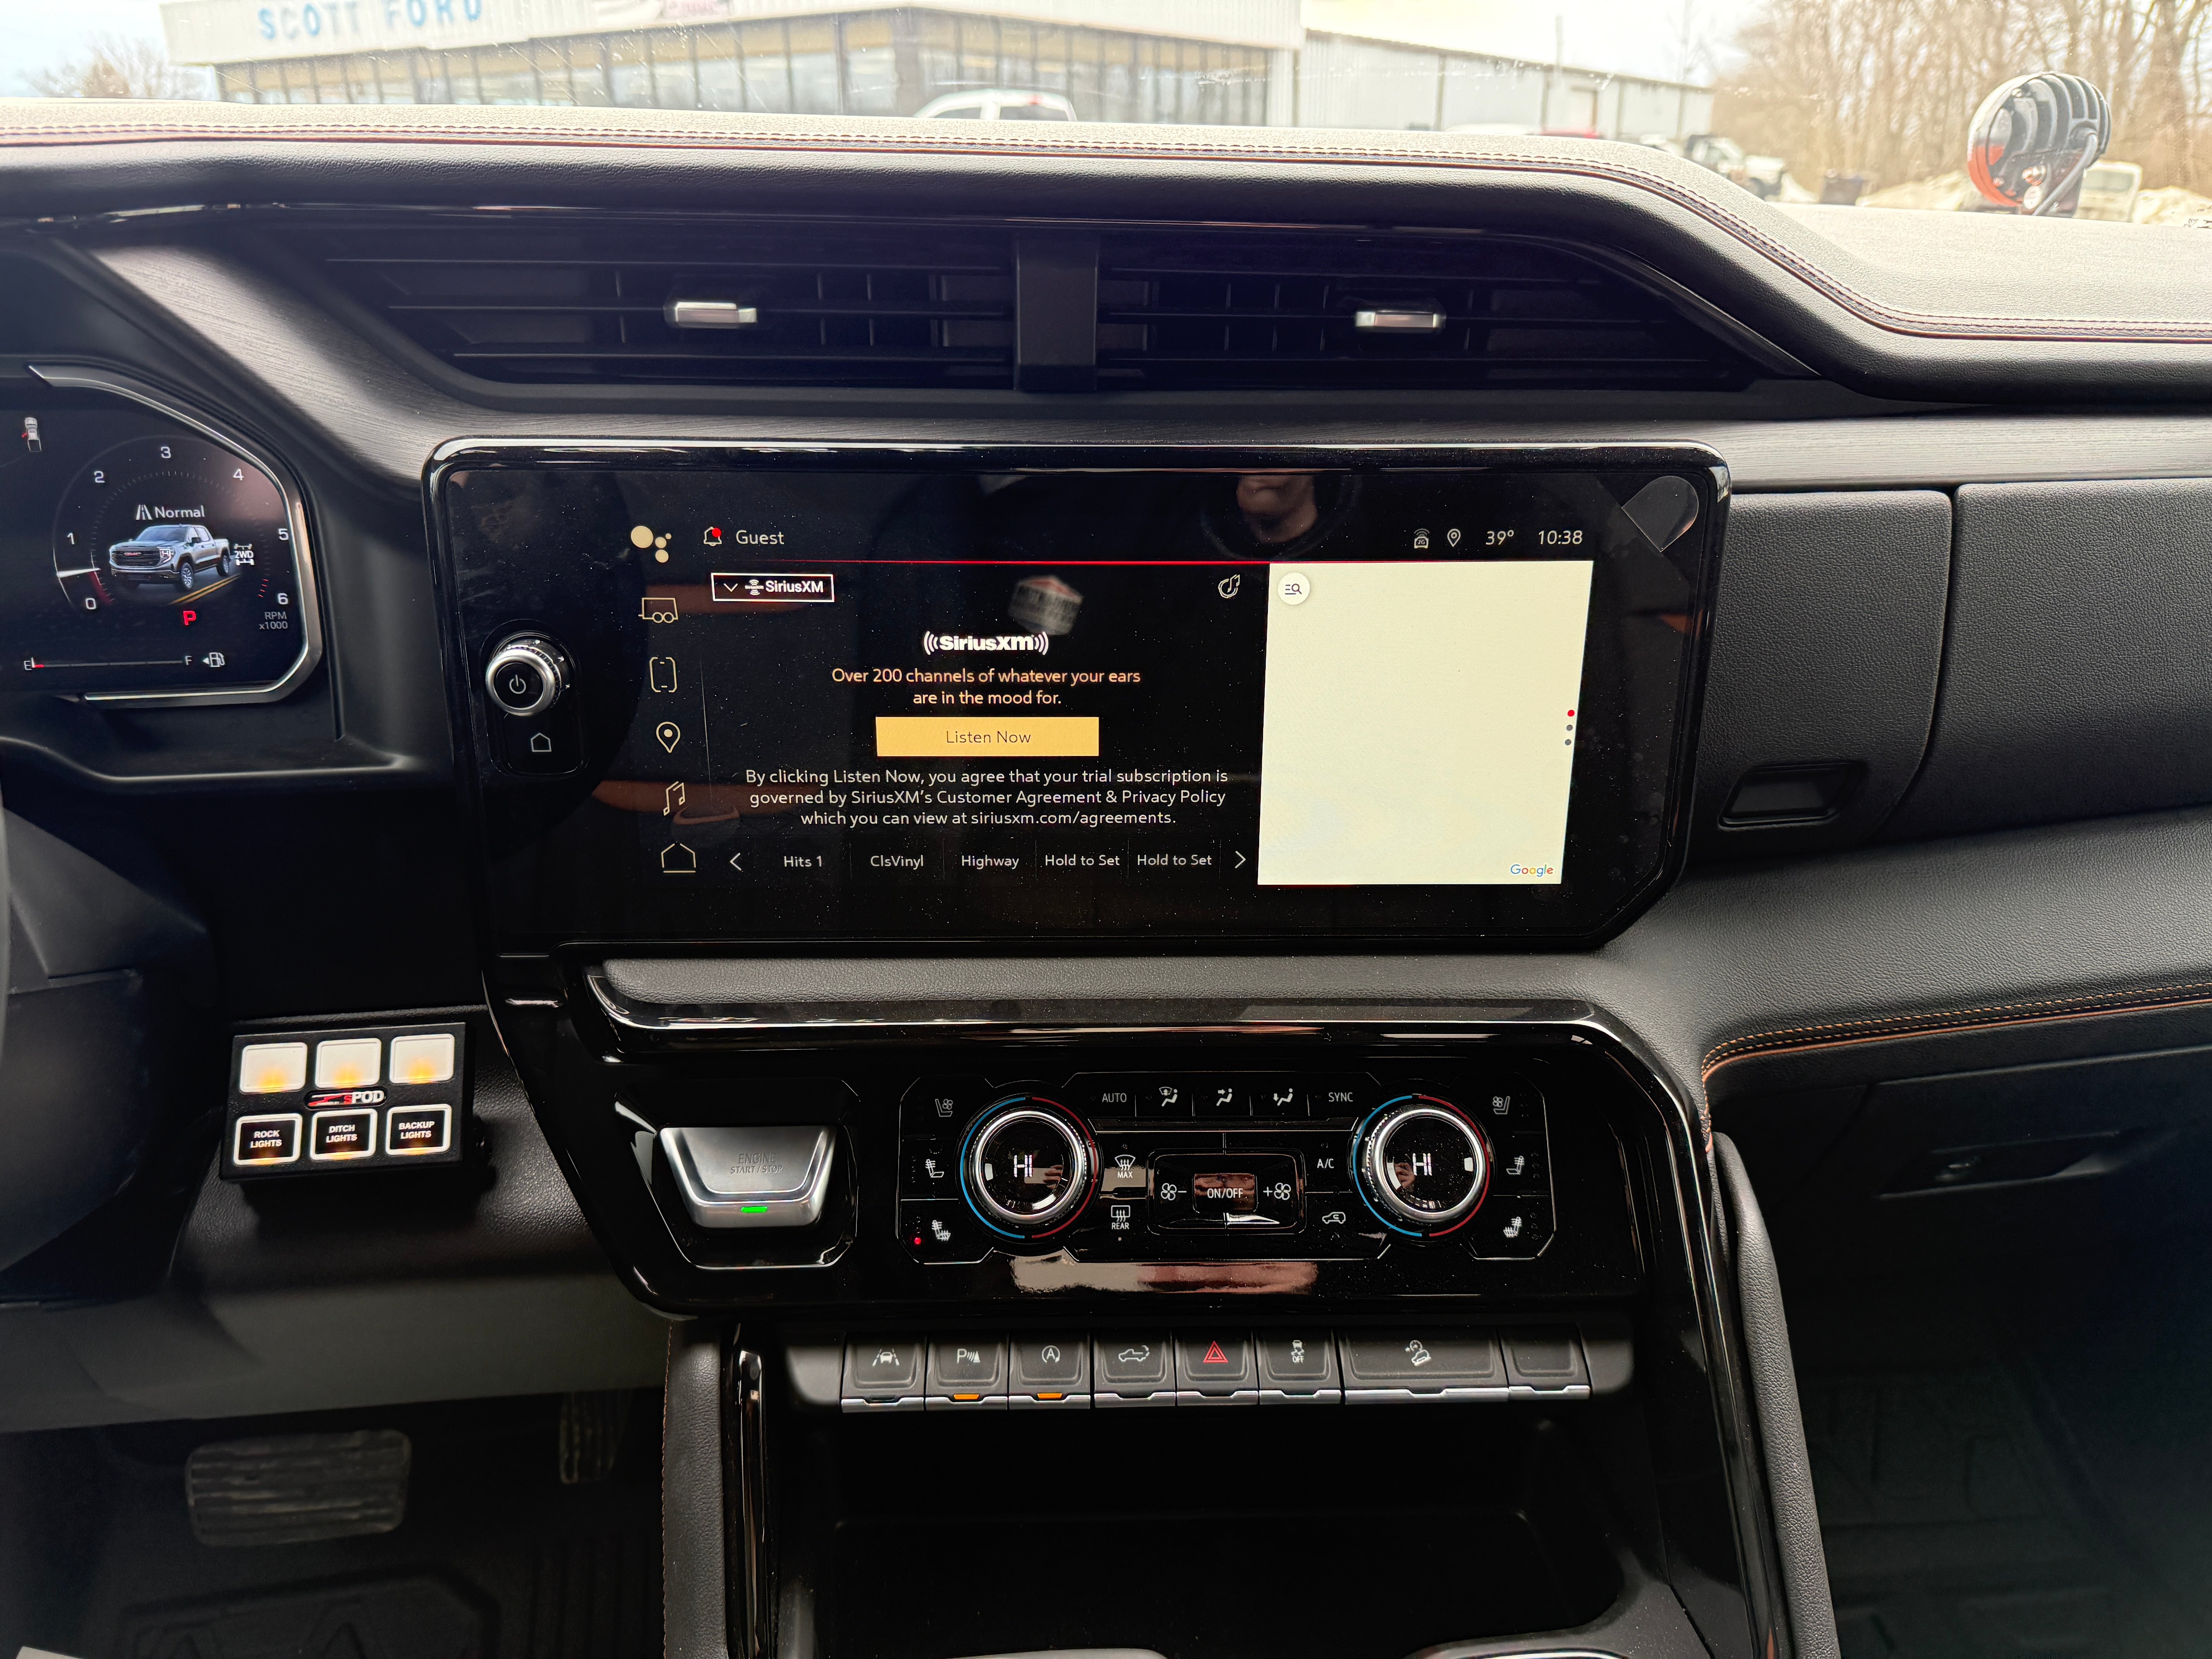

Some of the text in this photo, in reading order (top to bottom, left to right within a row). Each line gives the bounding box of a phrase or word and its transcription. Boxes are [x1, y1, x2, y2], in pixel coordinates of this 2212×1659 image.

[258, 2, 359, 40] SCOTT
[160, 446, 171, 459] 3
[94, 471, 105, 483] 2
[233, 468, 244, 481] 4
[155, 505, 205, 518] Normal
[67, 532, 75, 545] 1
[278, 528, 289, 541] 5
[736, 530, 785, 544] Guest
[1539, 530, 1583, 544] 10:38
[766, 580, 824, 592] SiriusXM
[85, 598, 96, 610] 0
[277, 592, 289, 605] 6
[183, 610, 196, 625] P
[264, 611, 287, 620] RPM
[259, 621, 288, 629] x1000
[184, 655, 192, 665] F
[832, 668, 1141, 687] Over 200 channels of whatever your ears
[913, 690, 1061, 704] are in the mood for.
[947, 731, 1031, 743] Listen Now
[746, 768, 1228, 787] By clicking Listen Now, you agree that your trial subscription is
[750, 790, 823, 808] governed
[829, 790, 847, 808] by
[937, 790, 1012, 804] Customer
[1016, 790, 1102, 807] Agreement
[1106, 790, 1117, 803] &
[1123, 790, 1176, 807] Privacy
[1181, 789, 1226, 807] Policy
[800, 811, 1176, 828] which you can view at siriusxm.com/agreements.
[784, 855, 822, 867] Hits 1
[871, 854, 924, 870] ClsVinyl
[962, 854, 1019, 870] Highway
[1045, 854, 1120, 866] Hold to Set
[1137, 854, 1212, 866] Hold to Set
[1511, 864, 1553, 877] Google
[1102, 1093, 1127, 1103] AUTO
[1328, 1092, 1353, 1102] SYNC
[328, 1124, 357, 1133] DITCH
[398, 1121, 435, 1130] BACKUP
[254, 1130, 282, 1139] ROCK
[326, 1133, 357, 1143] LIGHTS
[400, 1130, 432, 1139] LIGHTS
[250, 1139, 282, 1148] LIGHTS
[739, 1153, 778, 1164] ENGINE
[1317, 1158, 1334, 1169] A/C
[1412, 1153, 1432, 1176] HI
[1013, 1154, 1032, 1178] HI
[1207, 1188, 1243, 1199] ON/OFF
